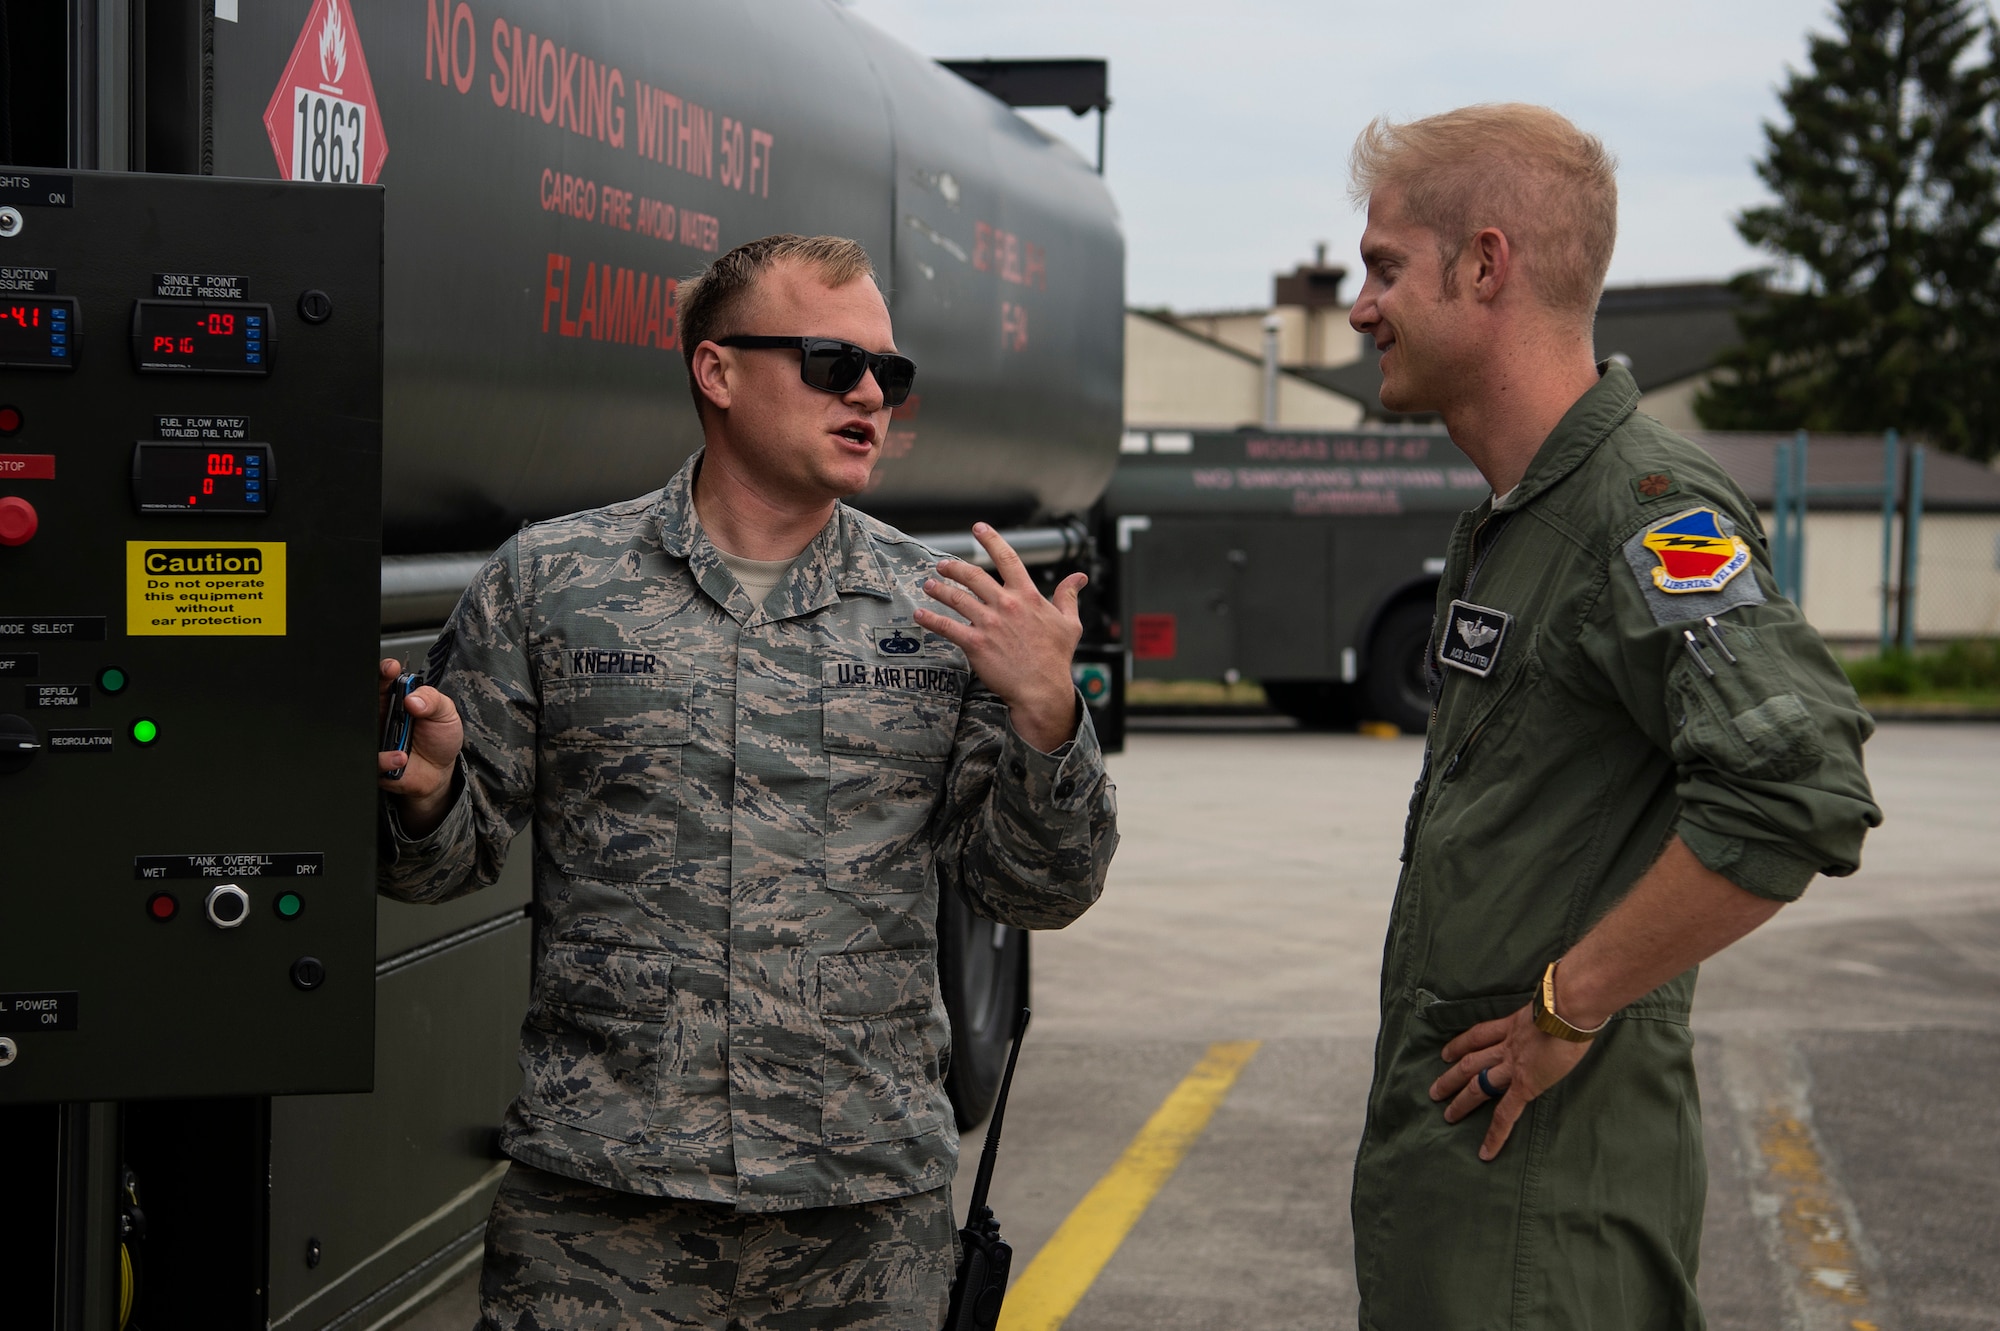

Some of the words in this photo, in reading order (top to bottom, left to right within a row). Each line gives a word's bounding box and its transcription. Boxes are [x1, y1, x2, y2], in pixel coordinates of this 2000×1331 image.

[425, 0, 476, 94] NO
[490, 18, 625, 149] SMOKING
[635, 79, 713, 180] WITHIN
[720, 117, 745, 190] 50
[750, 128, 774, 198] FT
[298, 94, 360, 184] 1863
[48, 193, 66, 204] ON
[541, 168, 596, 222] CARGO
[601, 185, 633, 231] FIRE
[636, 197, 676, 242] AVOID
[680, 208, 719, 253] WATER
[1, 269, 49, 280] SUCTION
[163, 275, 200, 287] SINGLE
[206, 277, 238, 287] POINT
[158, 286, 192, 297] NOZZLE
[197, 287, 242, 299] PRESSURE
[542, 253, 684, 353] FLAMMAB
[160, 418, 182, 427] FUEL
[187, 418, 212, 427] FLOW
[216, 419, 244, 428] RATE/
[160, 428, 200, 438] TOTALIZED
[202, 429, 221, 438] FUEL
[224, 429, 245, 438] FLOW
[146, 552, 260, 573] Caution
[147, 580, 169, 589] Do
[175, 579, 200, 589] not
[205, 579, 265, 590] operate
[1662, 578, 1713, 590] LIBERTAS
[145, 591, 175, 601] this
[179, 591, 264, 603] equipment
[175, 603, 234, 613] without
[151, 617, 177, 626] ear
[181, 615, 262, 627] protection
[31, 623, 75, 634] SELECT
[574, 652, 657, 674] KNEPLER
[874, 666, 902, 689] AIR
[903, 668, 957, 695] FORCE
[39, 687, 78, 696] DEFUEL/
[39, 697, 78, 706] DE-DRUM
[51, 736, 113, 746] RECIRCULATION
[188, 856, 216, 867] TANK
[222, 855, 273, 866] OVERFILL
[142, 867, 167, 878] WET
[202, 865, 262, 877] PRE-CHECK
[296, 864, 318, 875] DRY
[15, 999, 58, 1011] POWER
[41, 1013, 58, 1024] ON
